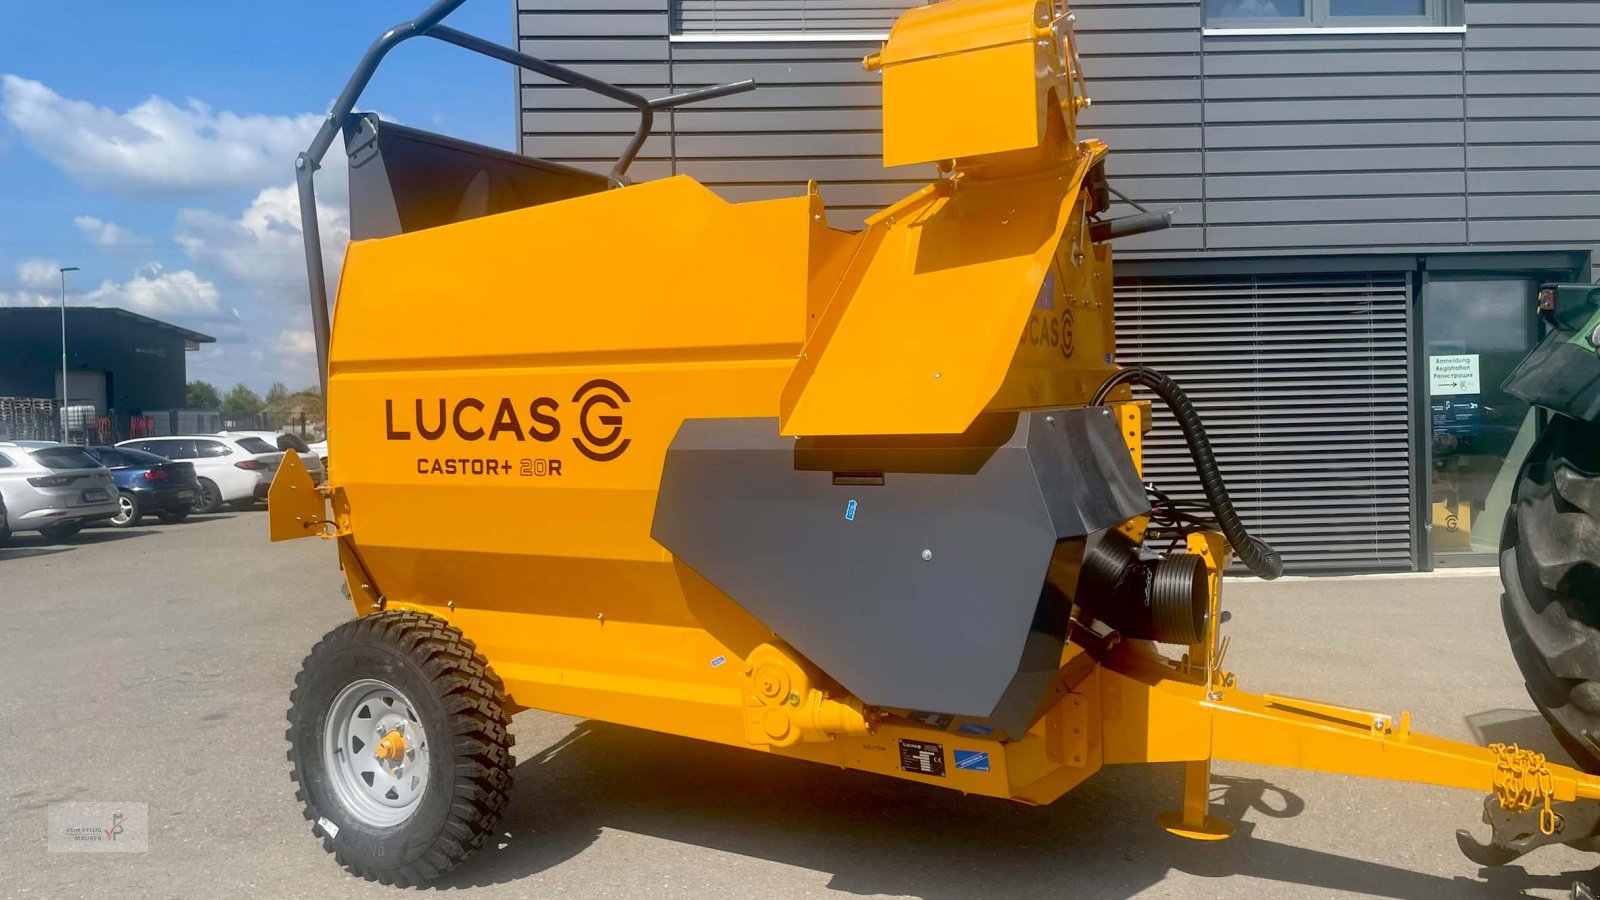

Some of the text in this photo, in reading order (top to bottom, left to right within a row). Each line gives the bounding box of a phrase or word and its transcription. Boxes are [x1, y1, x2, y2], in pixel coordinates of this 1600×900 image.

[385, 397, 561, 443] LUCAS
[417, 458, 562, 477] CASTOR+ 20R
